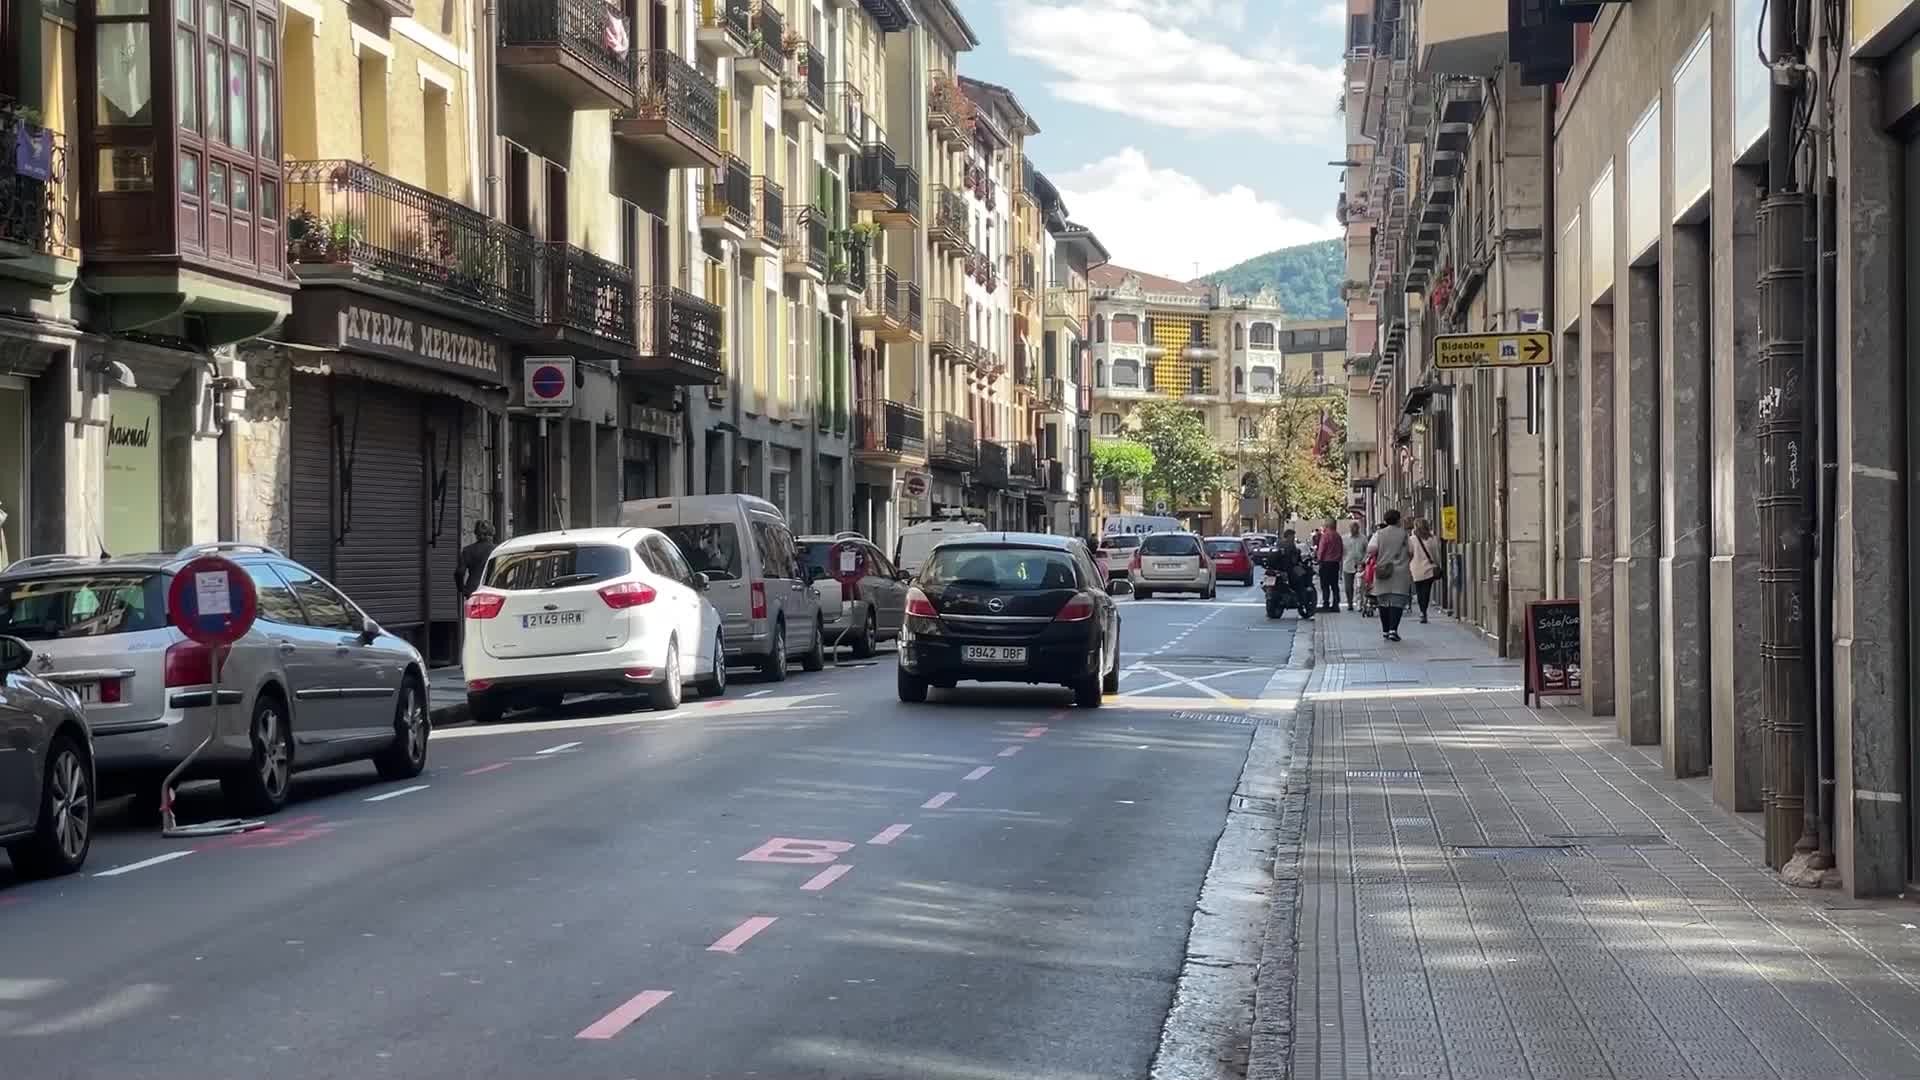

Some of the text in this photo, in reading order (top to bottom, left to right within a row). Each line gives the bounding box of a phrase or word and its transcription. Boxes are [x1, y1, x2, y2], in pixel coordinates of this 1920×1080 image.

[348, 306, 414, 351] AYERZA
[530, 612, 582, 627] 2149 HRW
[968, 647, 1024, 659] 3942 DBF
